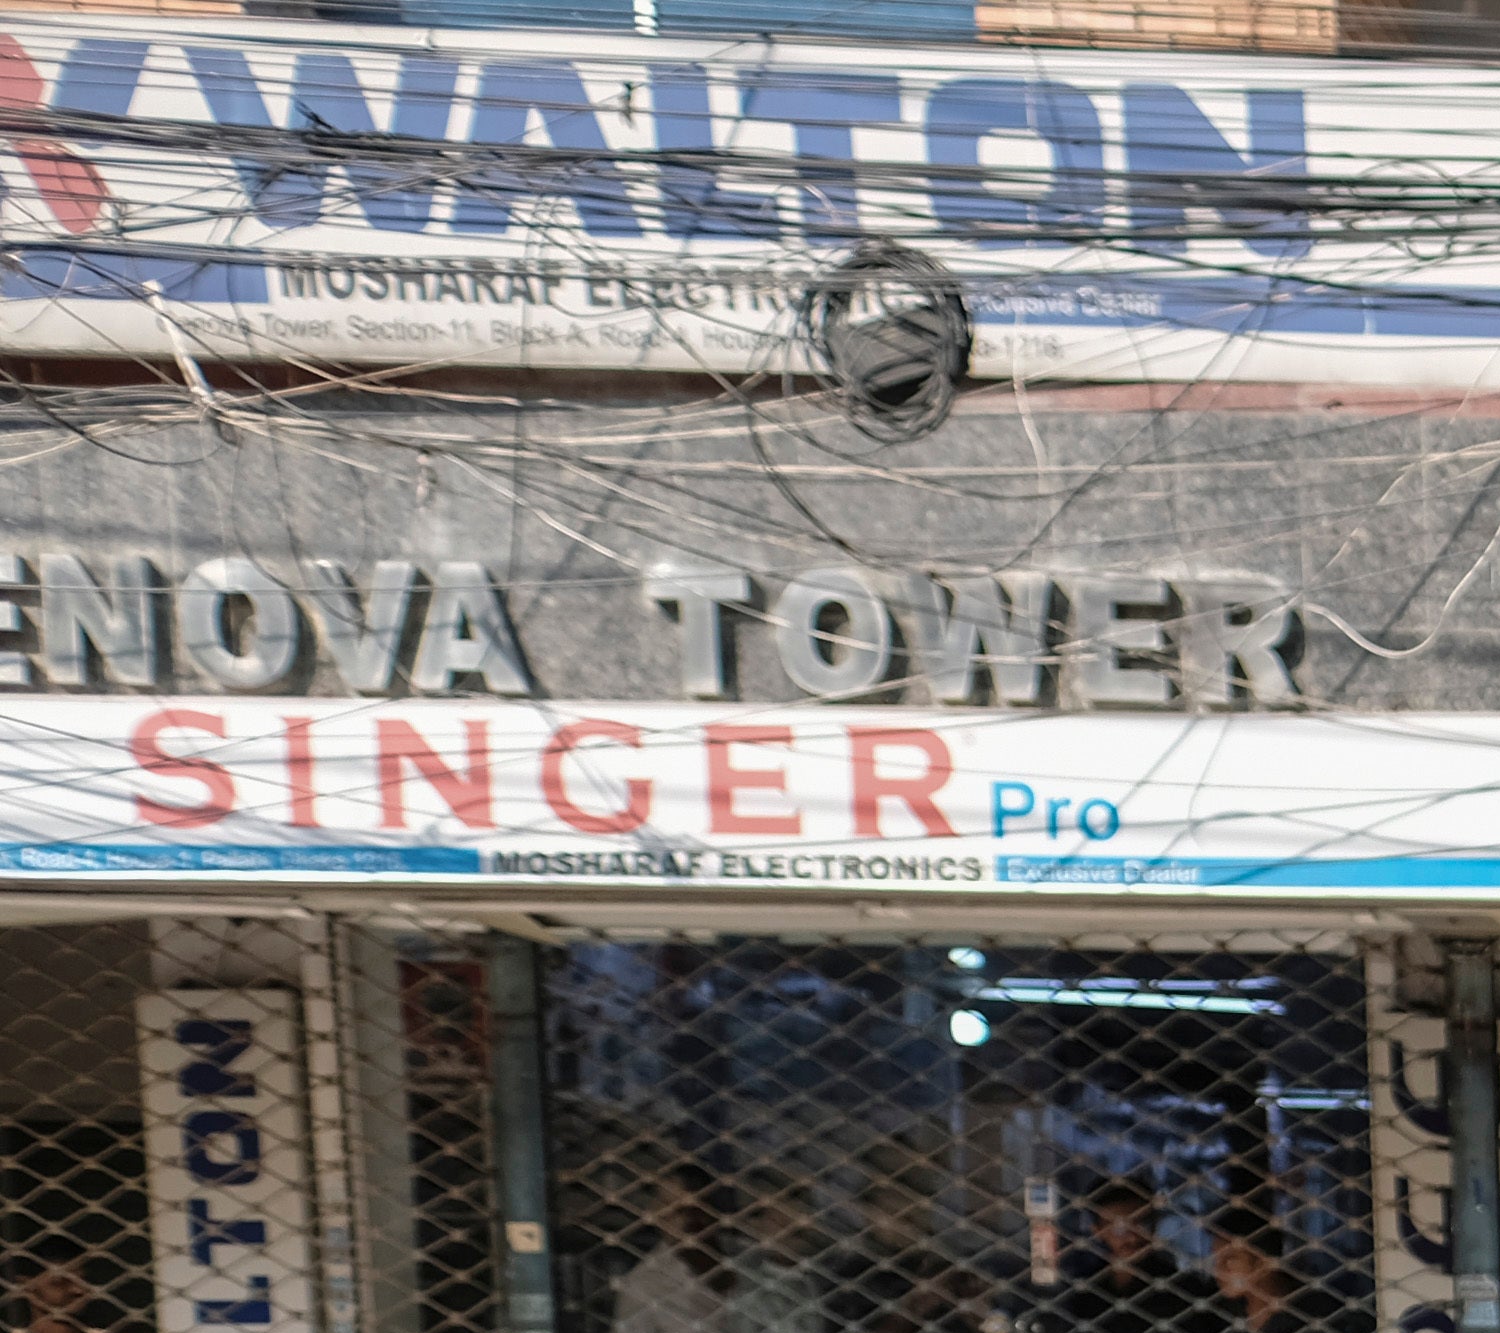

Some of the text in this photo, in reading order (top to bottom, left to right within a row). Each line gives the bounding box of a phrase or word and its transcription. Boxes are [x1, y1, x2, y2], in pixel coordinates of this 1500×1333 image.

[182, 45, 1314, 258] WALTON
[644, 563, 1304, 708] TOWER
[130, 708, 1122, 842] SINGER Pro
[496, 852, 983, 882] MOSHARAF ELECTRONICS
